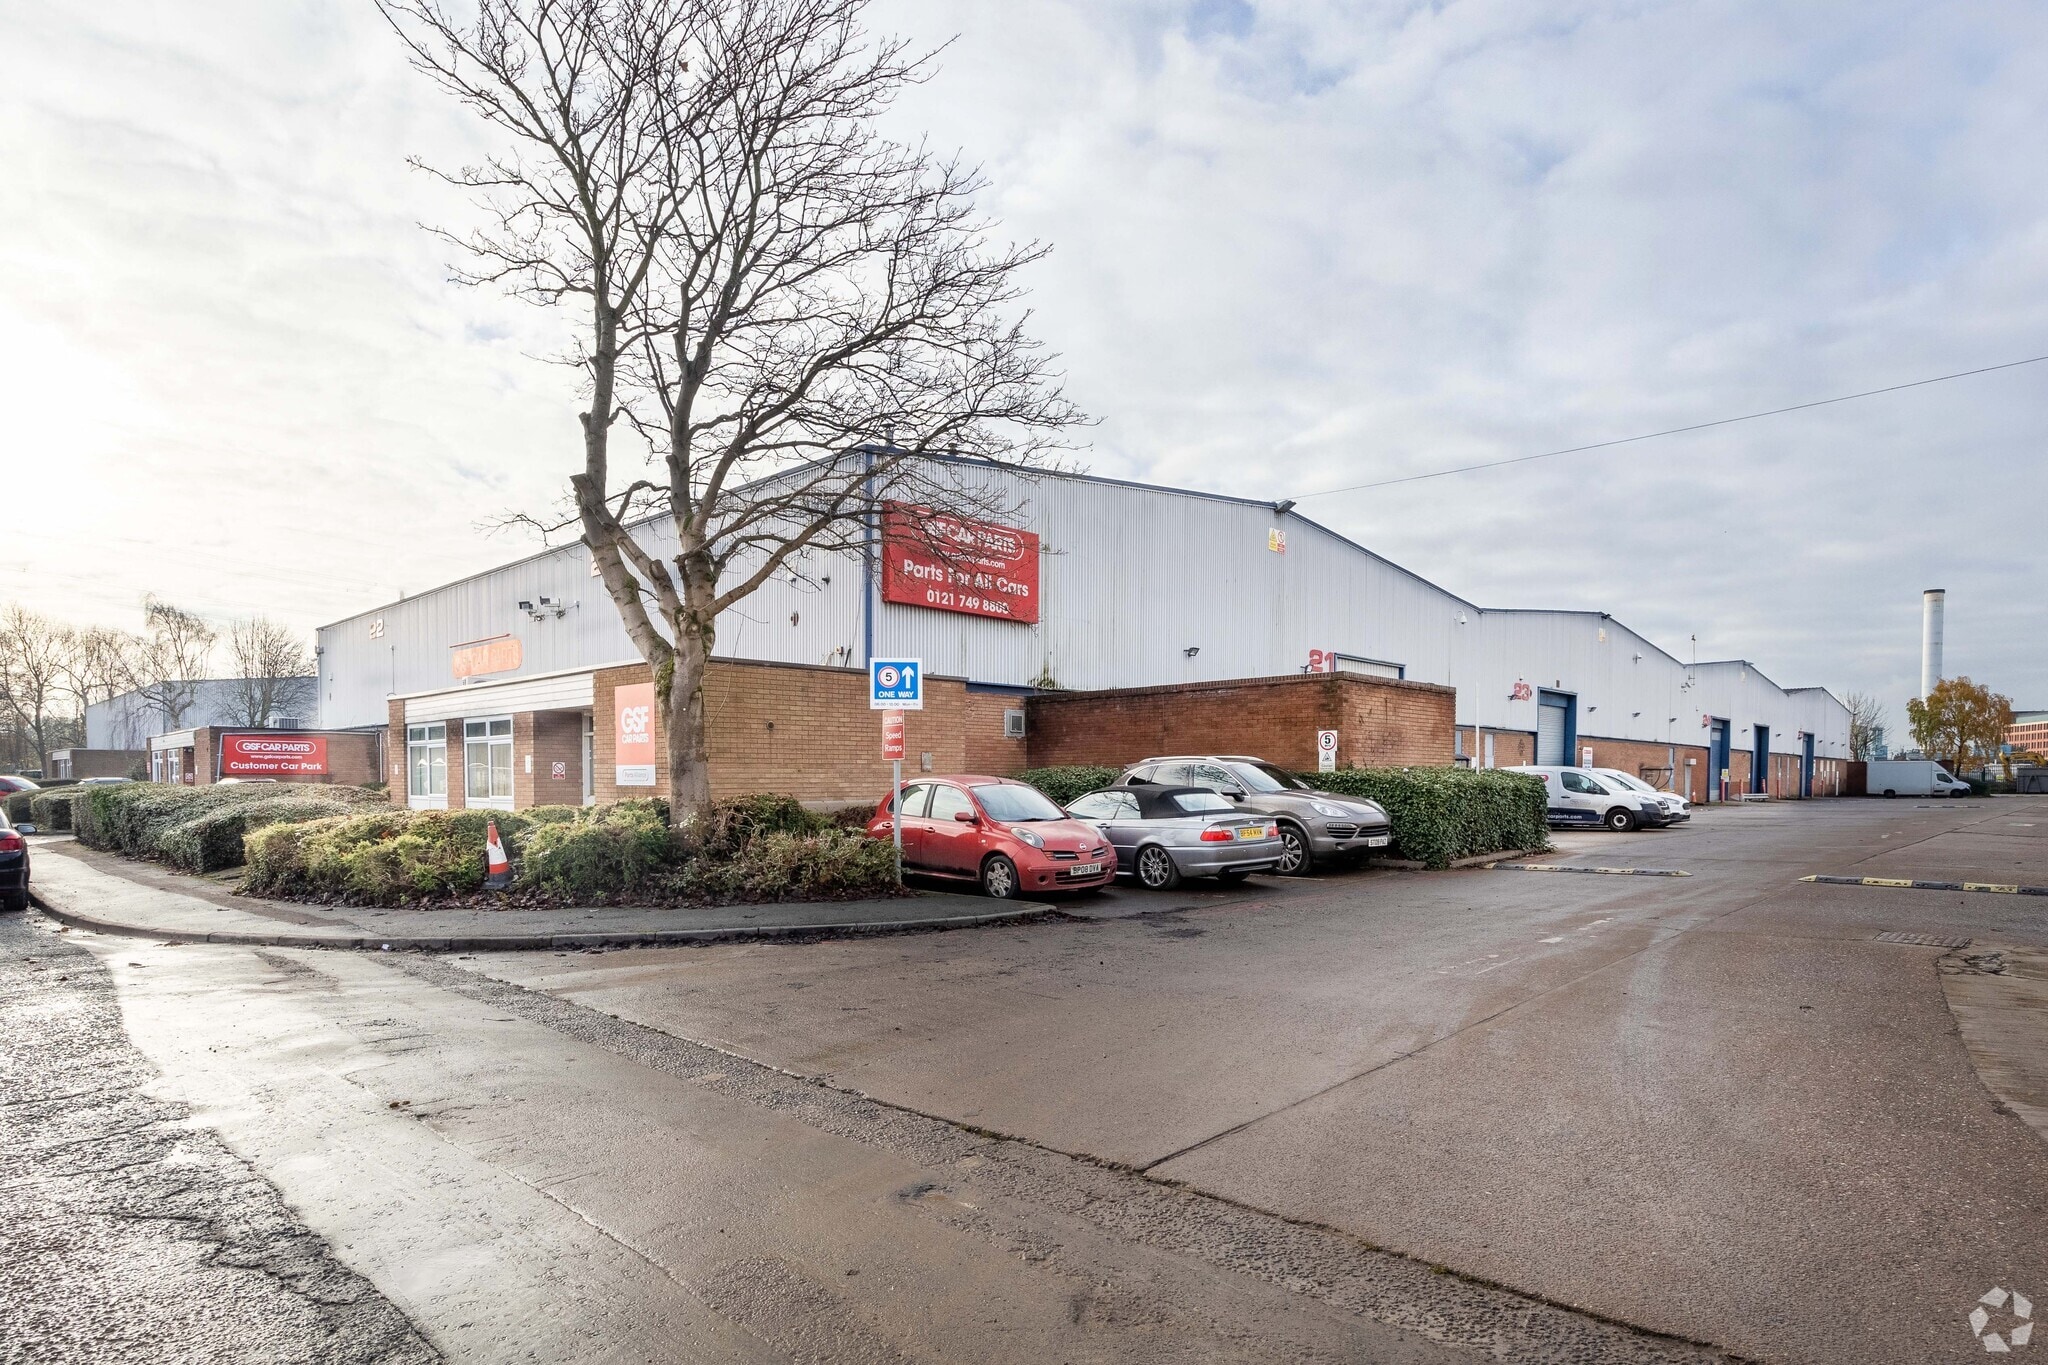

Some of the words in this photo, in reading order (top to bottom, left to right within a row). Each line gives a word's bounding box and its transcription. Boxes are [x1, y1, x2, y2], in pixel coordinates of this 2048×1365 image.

[977, 530, 1017, 554] PARTS
[904, 559, 943, 582] Parts
[974, 573, 993, 591] All
[996, 577, 1029, 598] Cars
[926, 589, 954, 607] 0121
[959, 594, 980, 610] 749
[369, 618, 384, 640] 22
[1309, 649, 1334, 673] 21
[885, 672, 892, 682] 5
[898, 690, 914, 698] WAY
[1513, 682, 1530, 701] 23
[621, 706, 649, 733] GSF
[622, 734, 633, 744] CAR
[885, 731, 902, 740] Speed
[1324, 735, 1331, 744] 5
[242, 742, 260, 751] GSF
[261, 742, 281, 751] CAR
[282, 743, 310, 752] PARTS
[885, 744, 902, 753] Ramps
[230, 761, 278, 770] Customer
[280, 762, 298, 770] Car
[301, 762, 322, 770] Park
